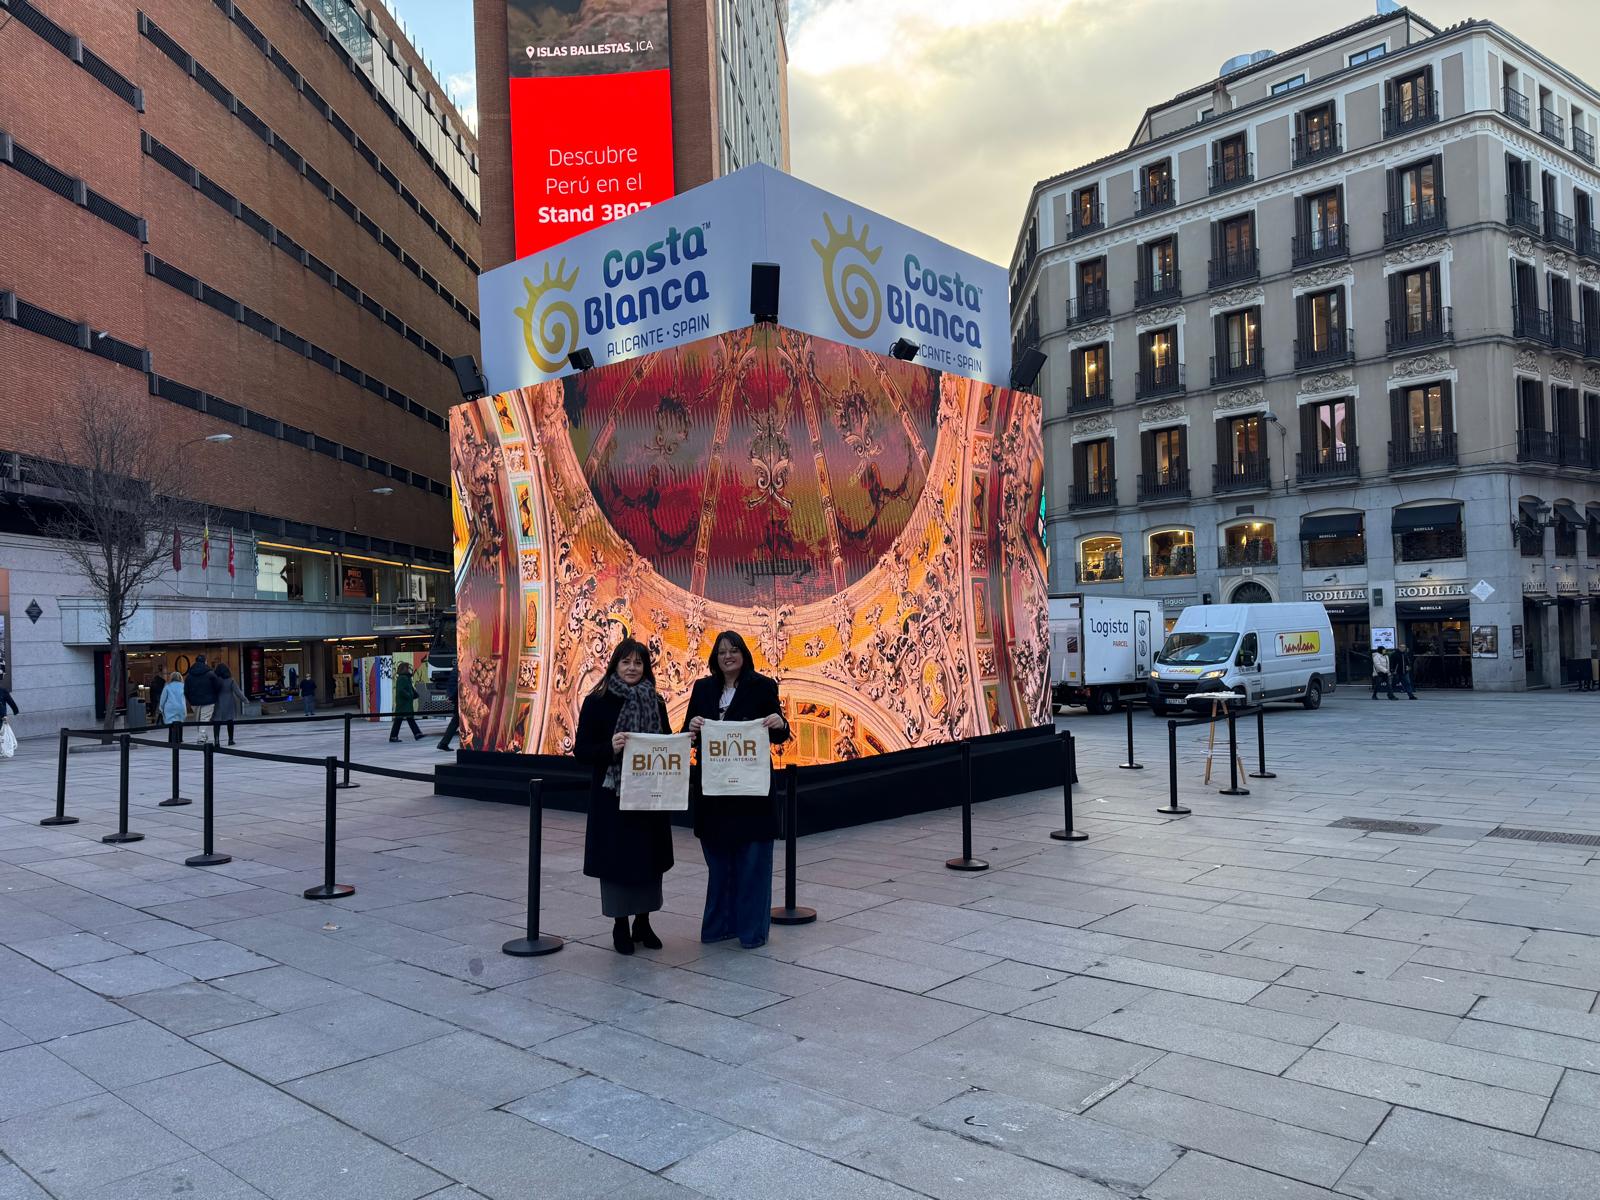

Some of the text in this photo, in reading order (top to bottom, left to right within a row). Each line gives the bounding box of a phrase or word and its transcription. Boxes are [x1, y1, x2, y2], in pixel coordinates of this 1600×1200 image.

[537, 40, 654, 57] ISLAS BALLESTAS, ICA
[549, 146, 638, 167] Descubre
[546, 172, 642, 195] Perú en el
[538, 204, 594, 224] Stand
[603, 226, 707, 288] Costa
[904, 253, 980, 313] Costa
[584, 270, 709, 335] Blanca
[887, 284, 982, 349] Blanca
[607, 313, 710, 357] ALICANTE SPAIN
[916, 343, 982, 372] ICANTE SPAIN
[1306, 589, 1367, 601] RODILLA
[1398, 585, 1466, 597] RODILLA
